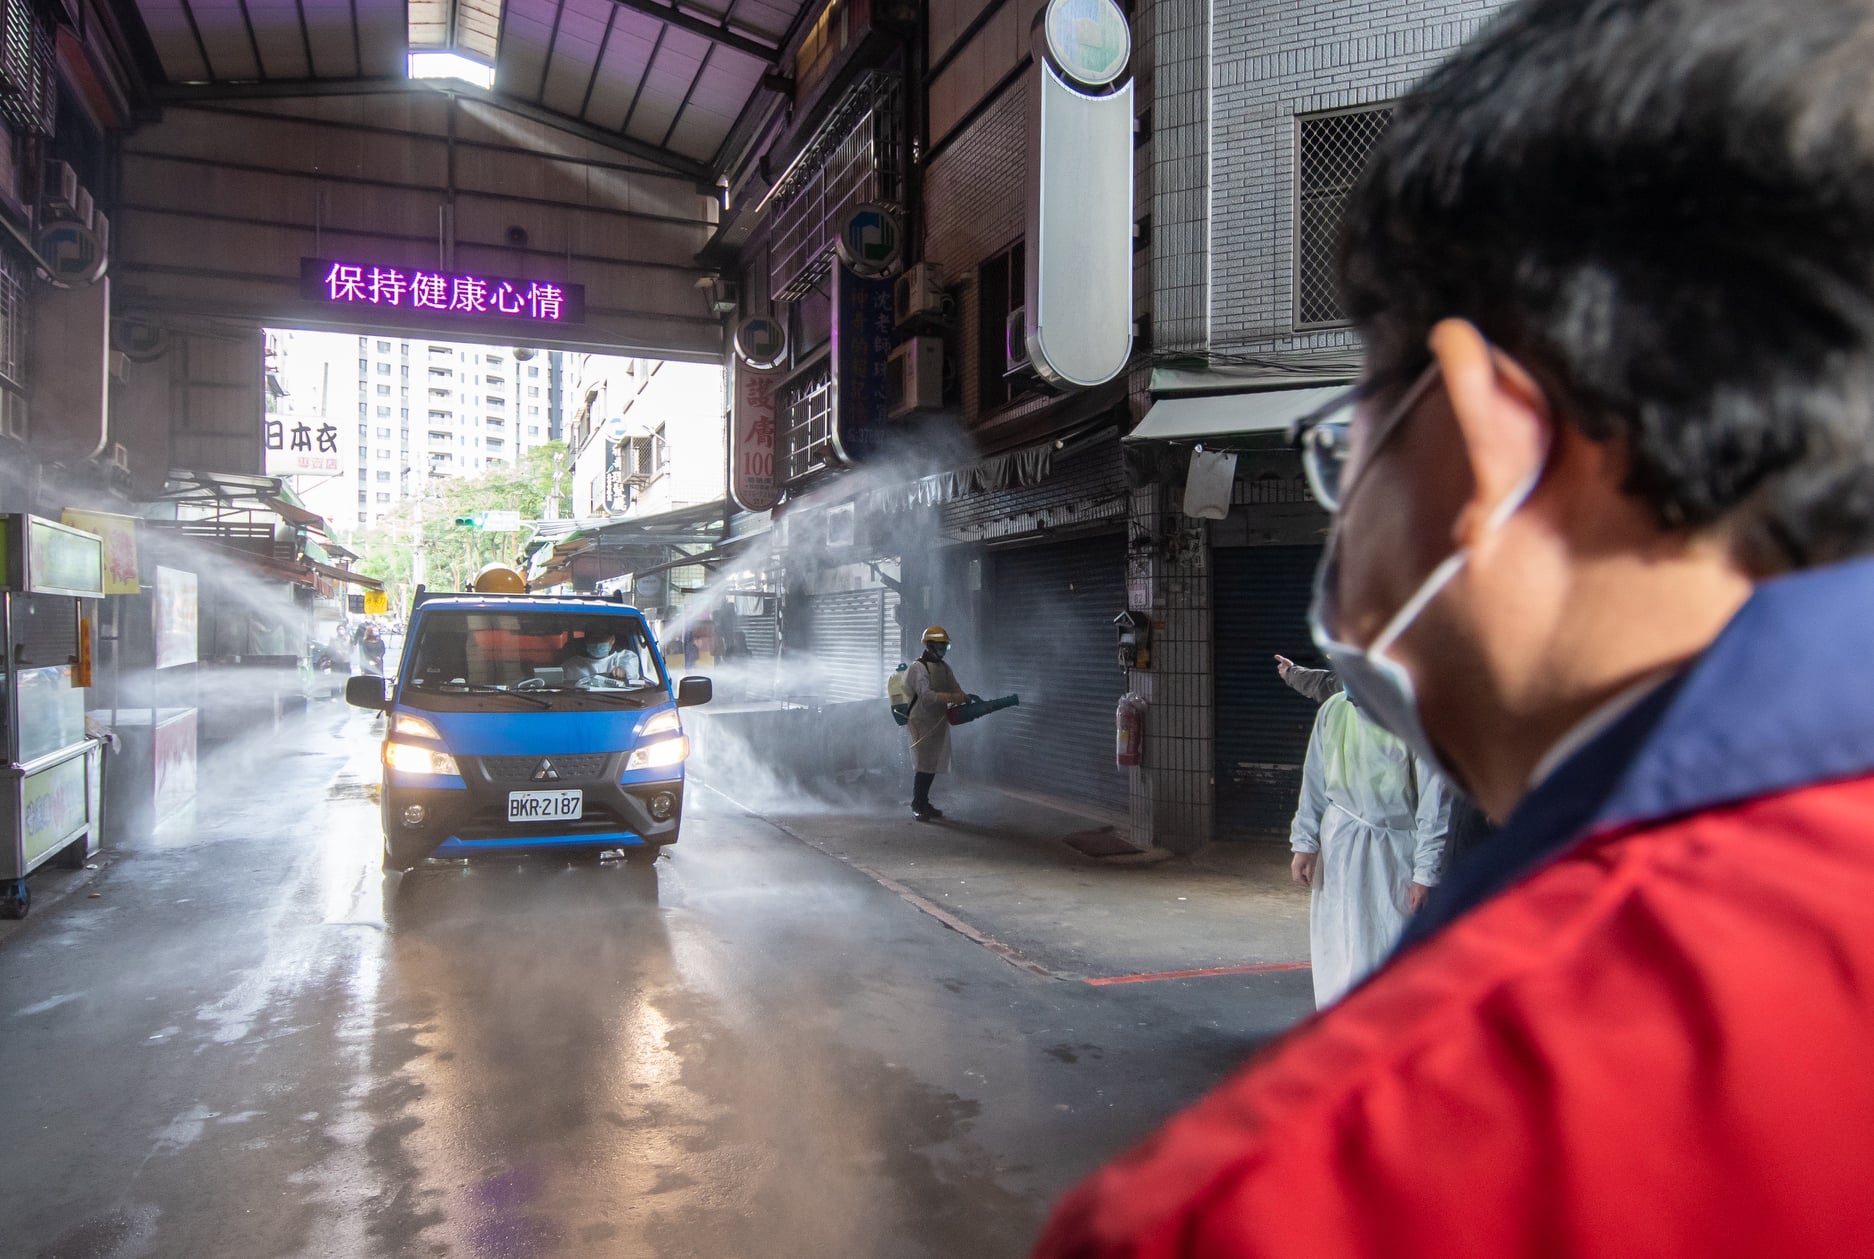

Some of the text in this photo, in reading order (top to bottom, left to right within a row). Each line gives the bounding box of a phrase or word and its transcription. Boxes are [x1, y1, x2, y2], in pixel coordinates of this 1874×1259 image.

[325, 263, 564, 320] 保持健康心情
[744, 376, 775, 449] 護膚
[744, 451, 774, 476] 100
